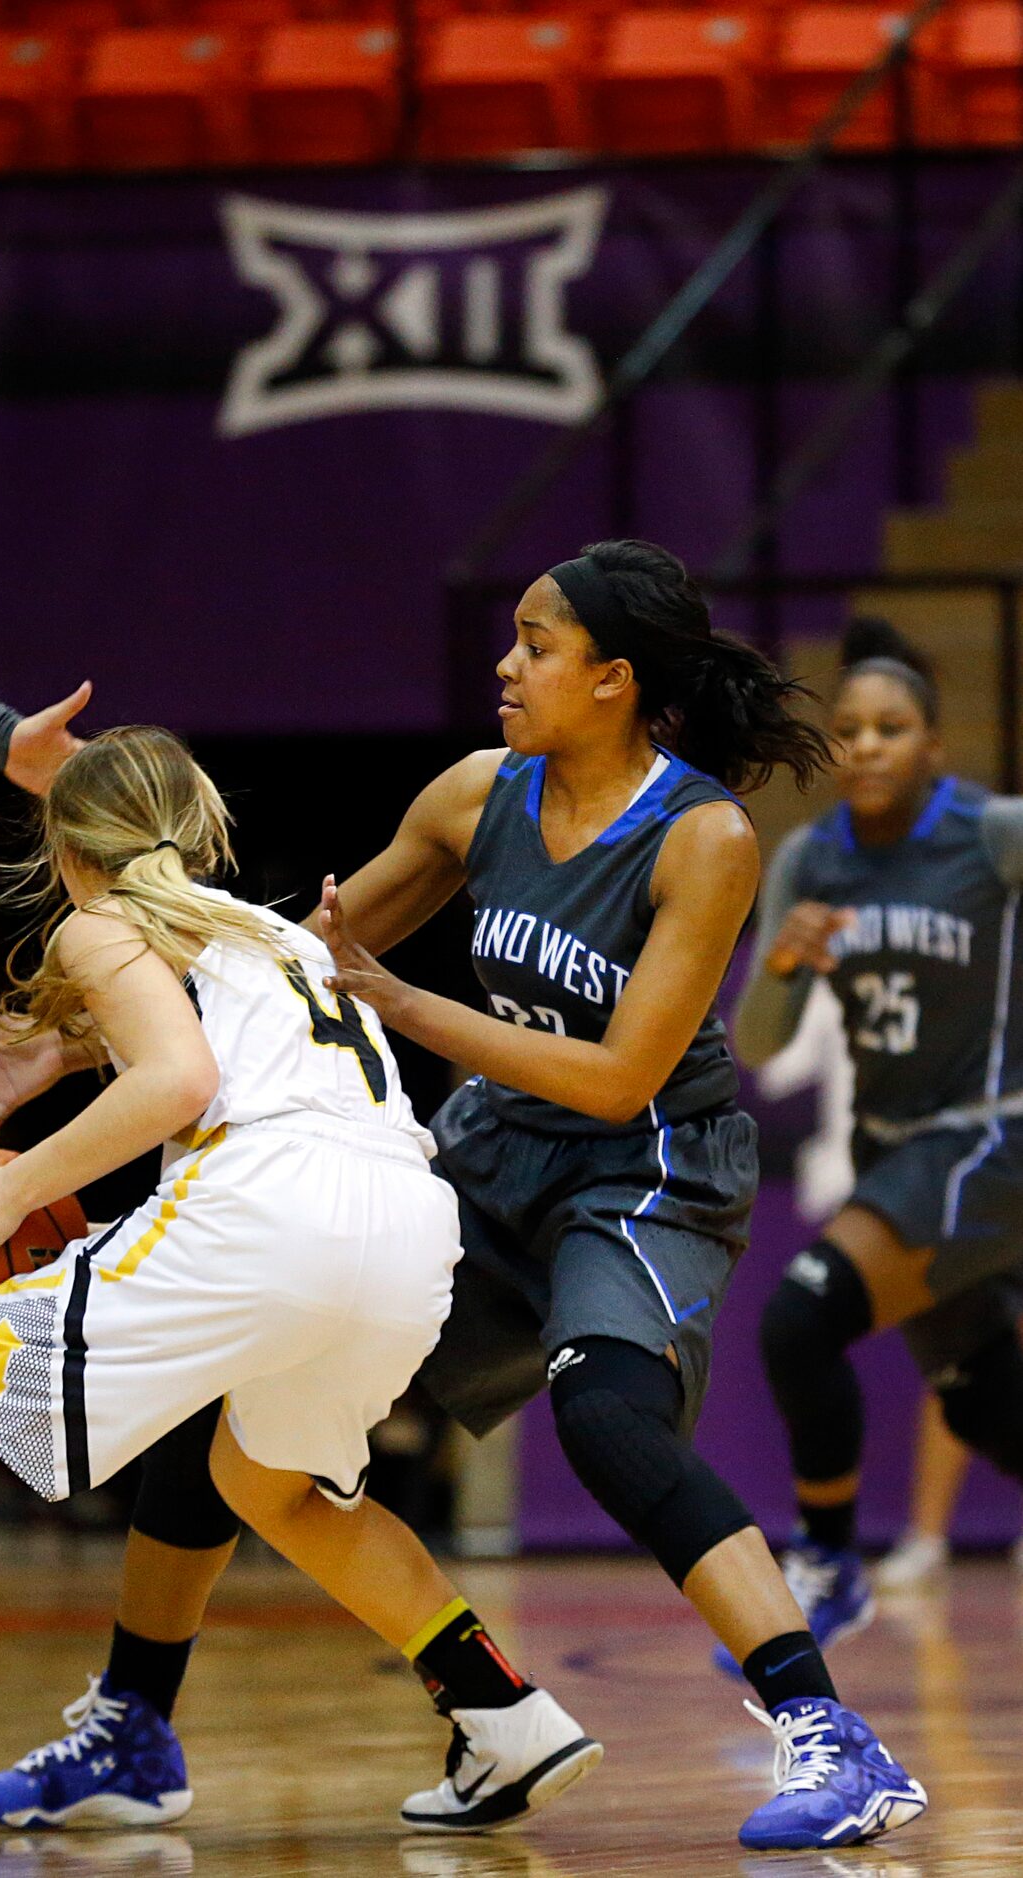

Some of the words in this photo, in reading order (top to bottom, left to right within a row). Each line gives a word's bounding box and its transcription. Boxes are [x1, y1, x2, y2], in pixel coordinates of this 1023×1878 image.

[471, 908, 538, 964] ANO
[537, 921, 631, 1005] WEST
[885, 904, 975, 966] WEST
[275, 957, 388, 1107] 4
[852, 970, 920, 1055] 25
